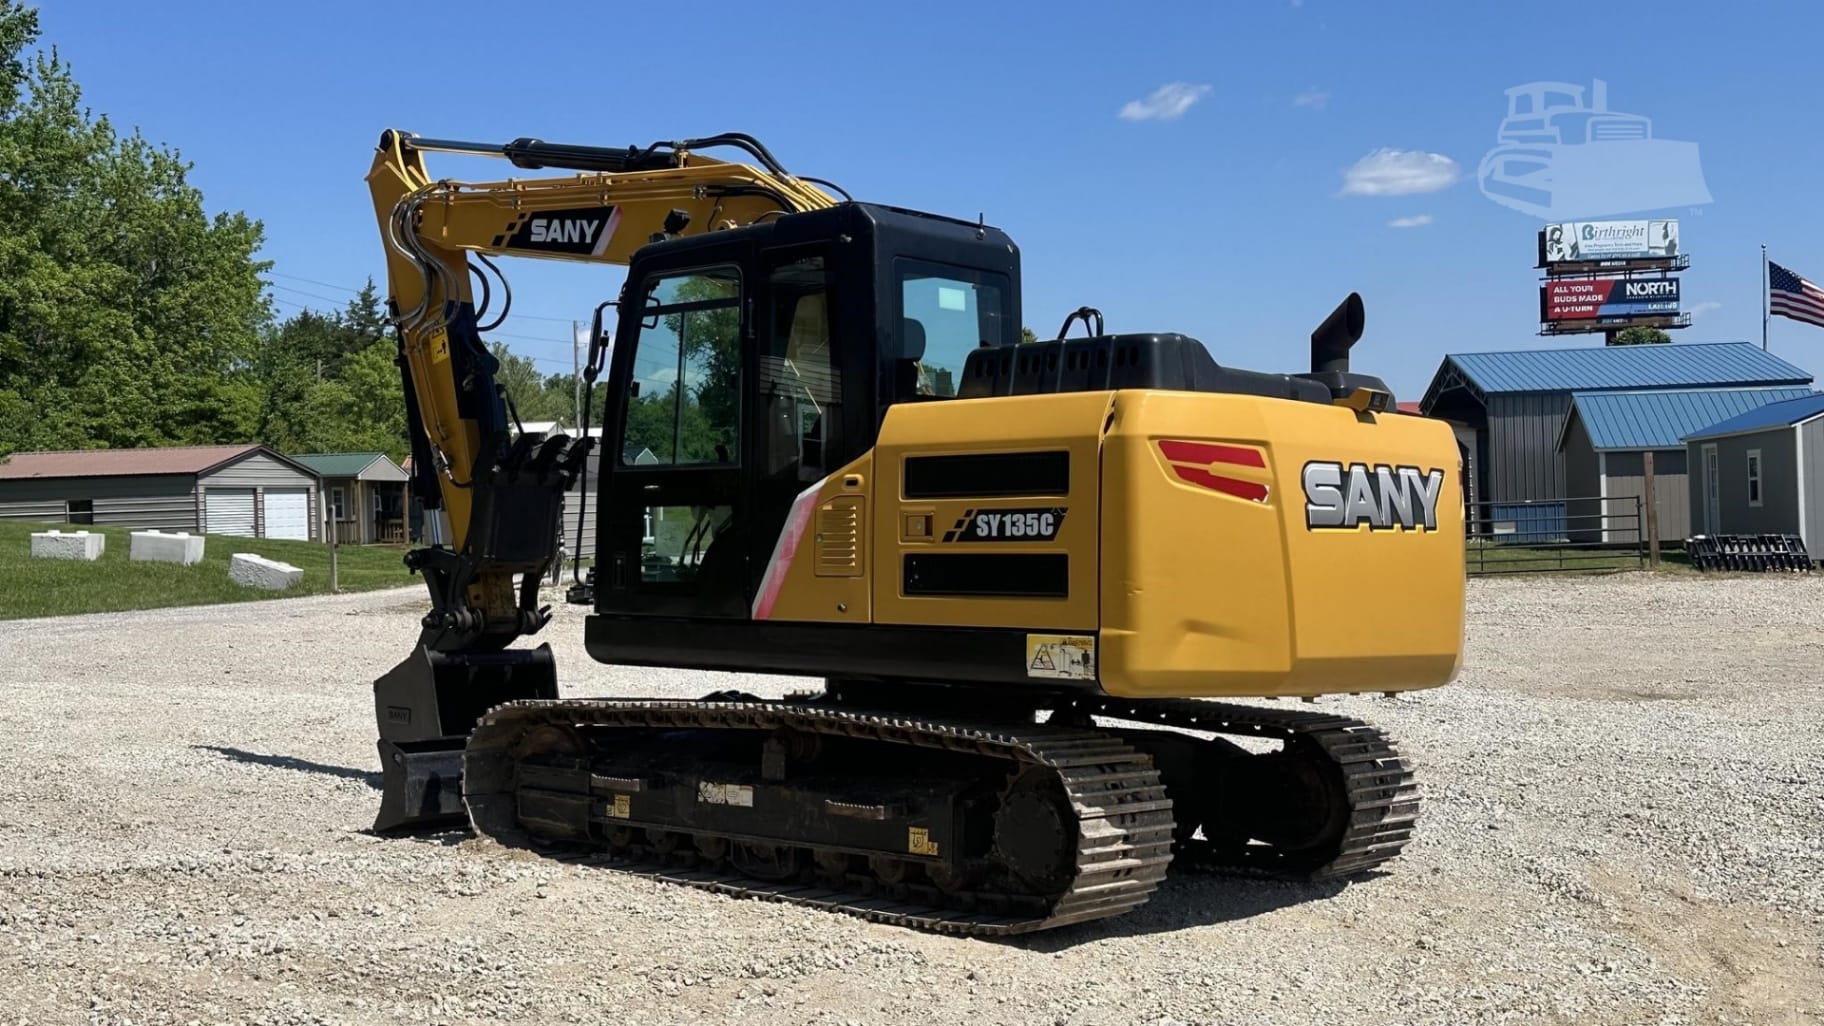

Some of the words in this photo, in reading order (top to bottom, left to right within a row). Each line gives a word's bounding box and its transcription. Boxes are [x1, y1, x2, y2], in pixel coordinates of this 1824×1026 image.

[530, 219, 600, 243] SANY
[1582, 224, 1646, 241] Birthright
[1570, 285, 1593, 293] YOUR
[1626, 281, 1677, 296] NORTH
[1554, 295, 1577, 303] BUDS
[1578, 294, 1604, 302] MADE
[1562, 305, 1593, 313] U-TURN
[1302, 460, 1444, 531] SANY
[976, 513, 1055, 537] SY135C
